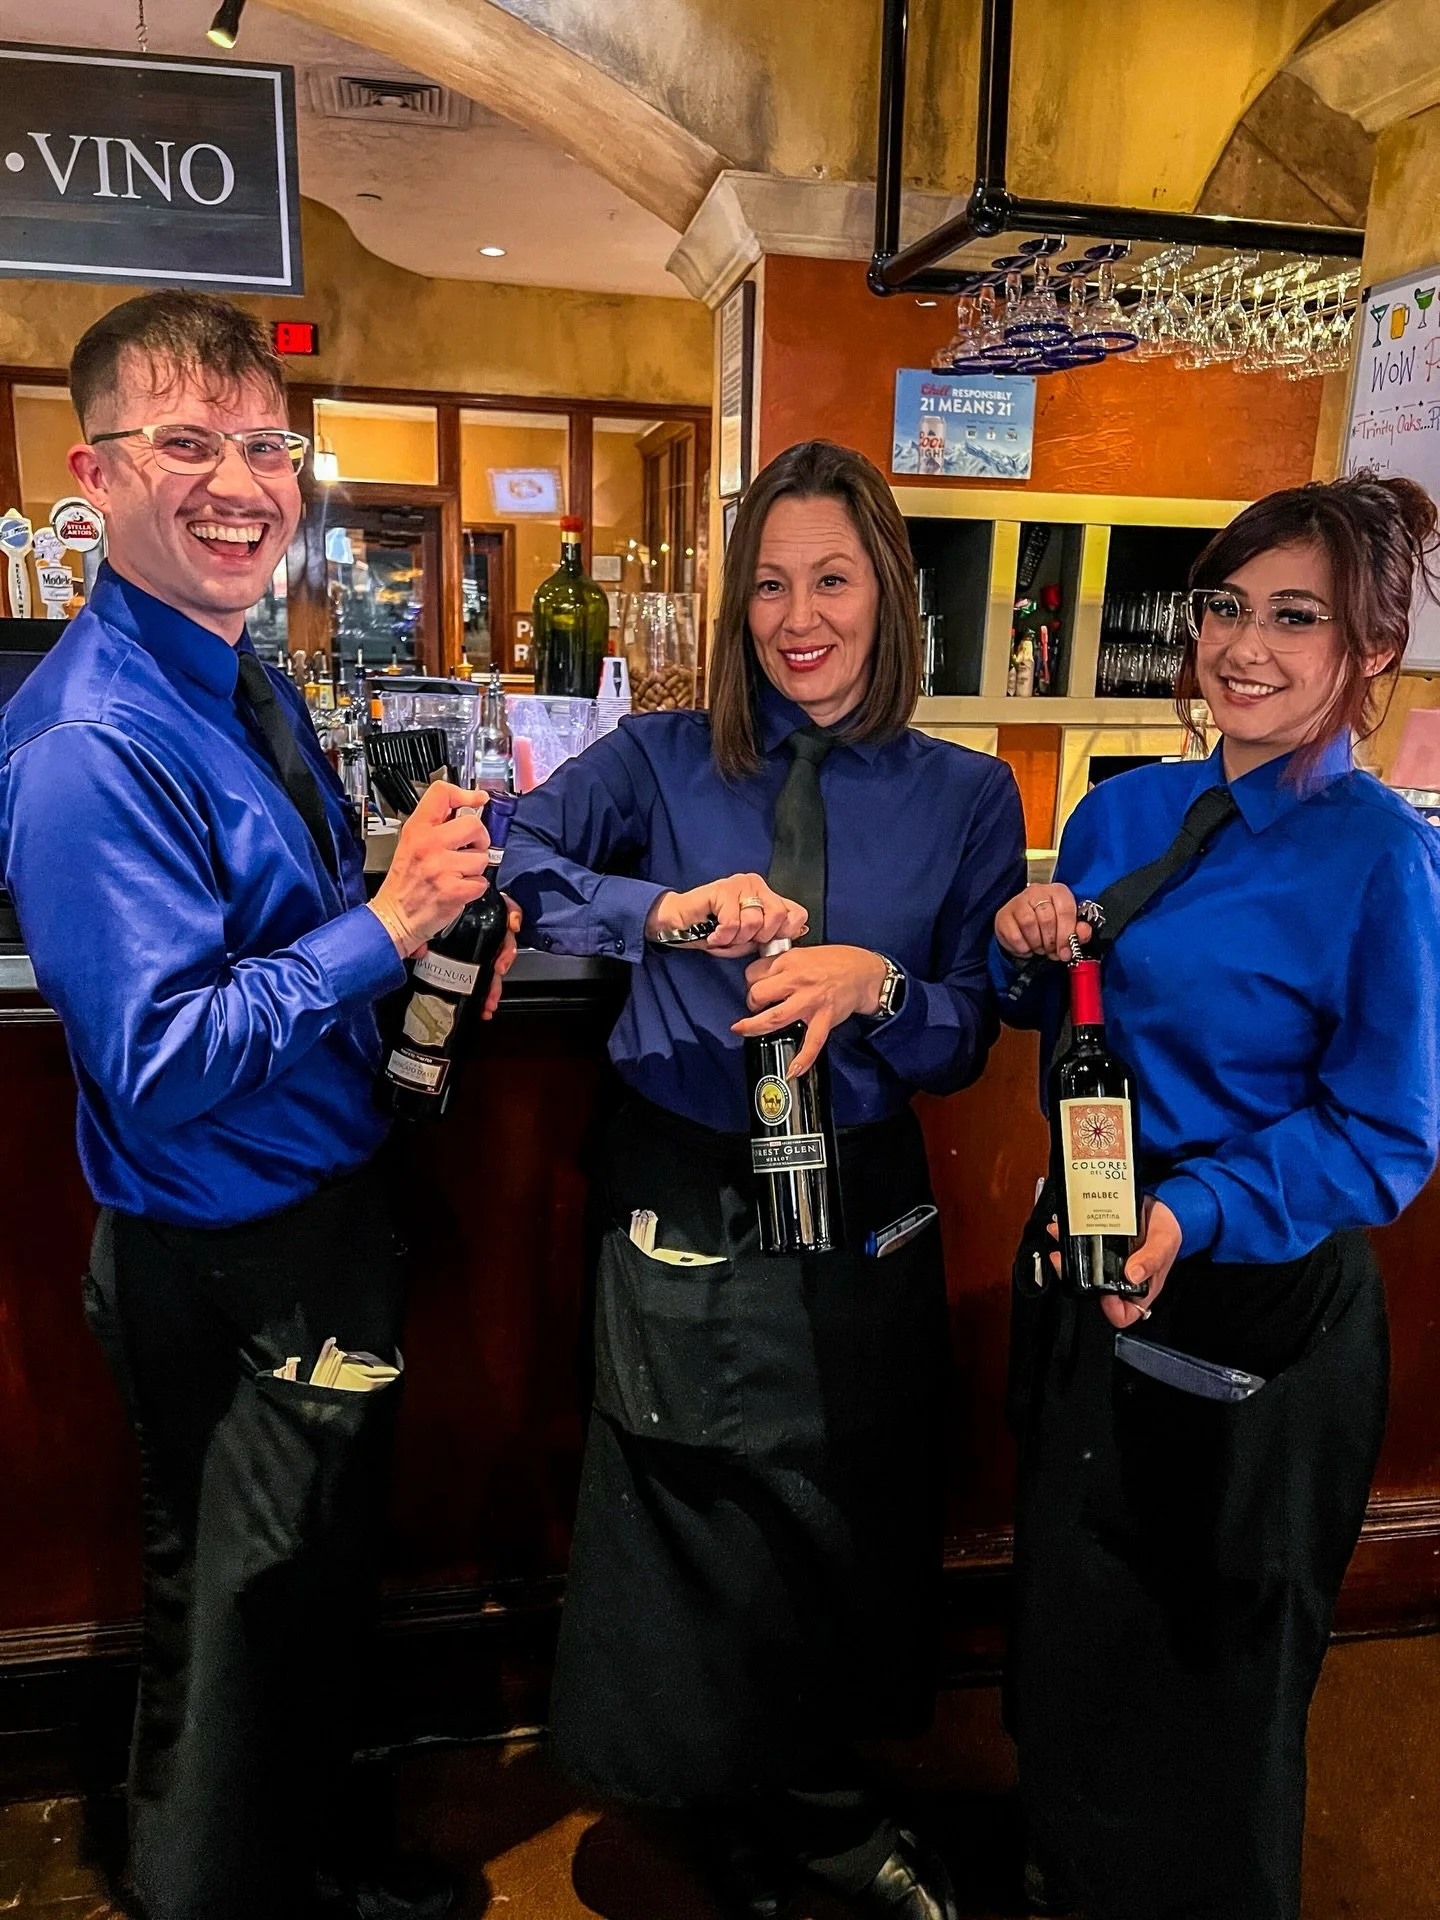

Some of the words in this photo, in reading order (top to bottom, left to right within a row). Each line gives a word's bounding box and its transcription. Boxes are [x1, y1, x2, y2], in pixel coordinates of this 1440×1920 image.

[27, 131, 235, 206] VINO
[952, 388, 1013, 401] RESPONSIBLY
[920, 397, 935, 412] 21
[938, 398, 995, 415] MEANS
[417, 957, 473, 984] BARTENURA
[783, 1145, 816, 1155] GLEN
[1071, 1161, 1127, 1170] COLORES
[1105, 1170, 1127, 1180] SOL
[1082, 1191, 1119, 1199] MALBEC
